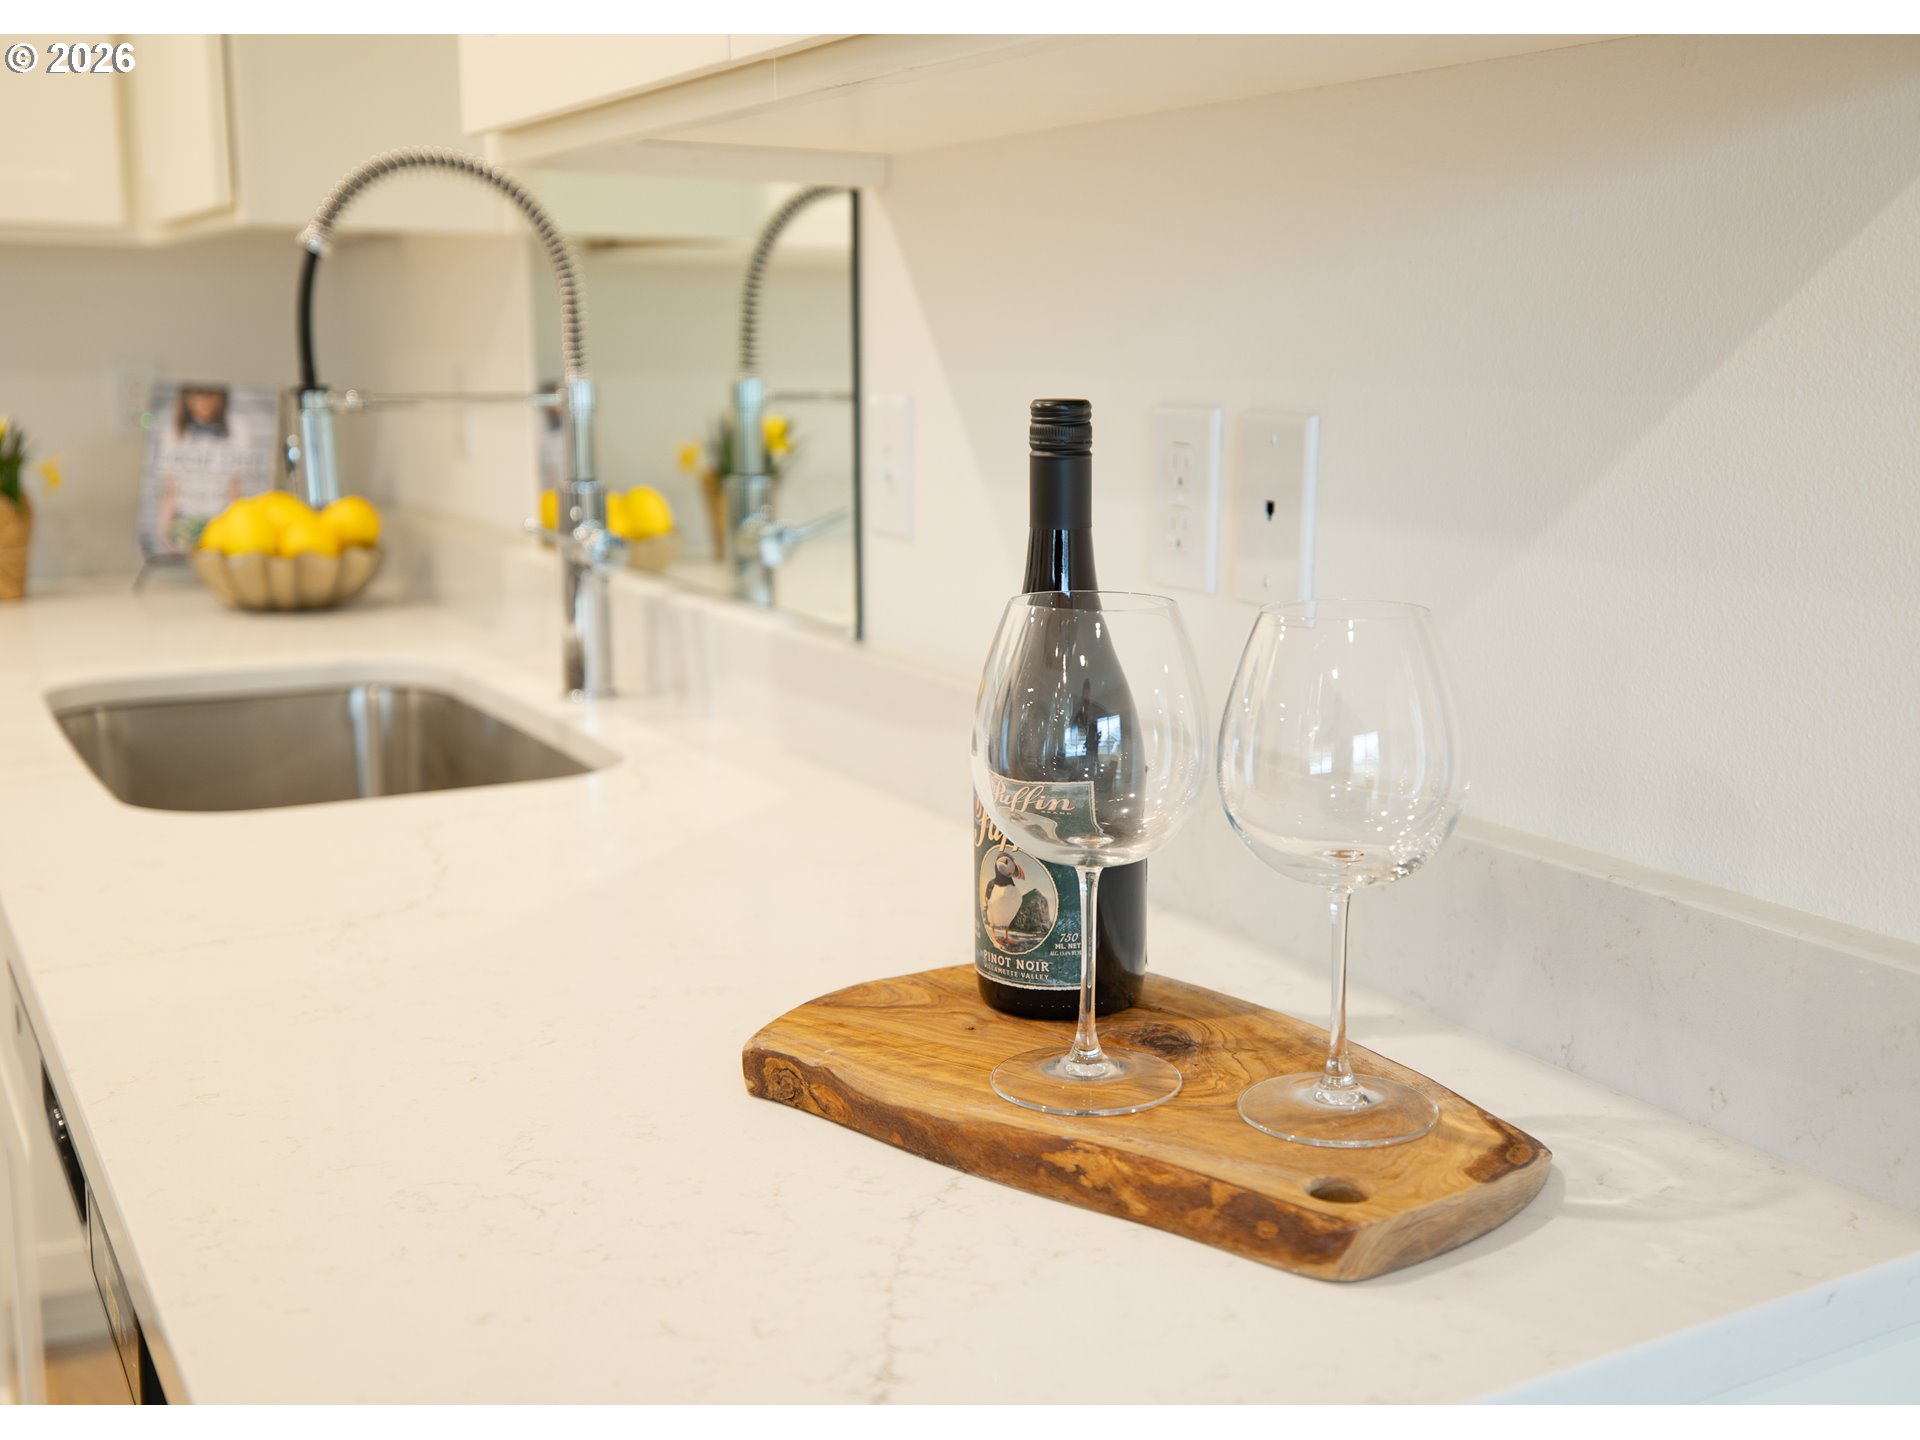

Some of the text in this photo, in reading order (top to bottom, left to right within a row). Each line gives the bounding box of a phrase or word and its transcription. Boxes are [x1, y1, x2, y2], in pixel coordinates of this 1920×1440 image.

[992, 778, 1075, 813] Puffin
[1059, 932, 1079, 942] 750
[983, 949, 1050, 972] PINOT NOIR
[1020, 972, 1049, 980] VALLEY
